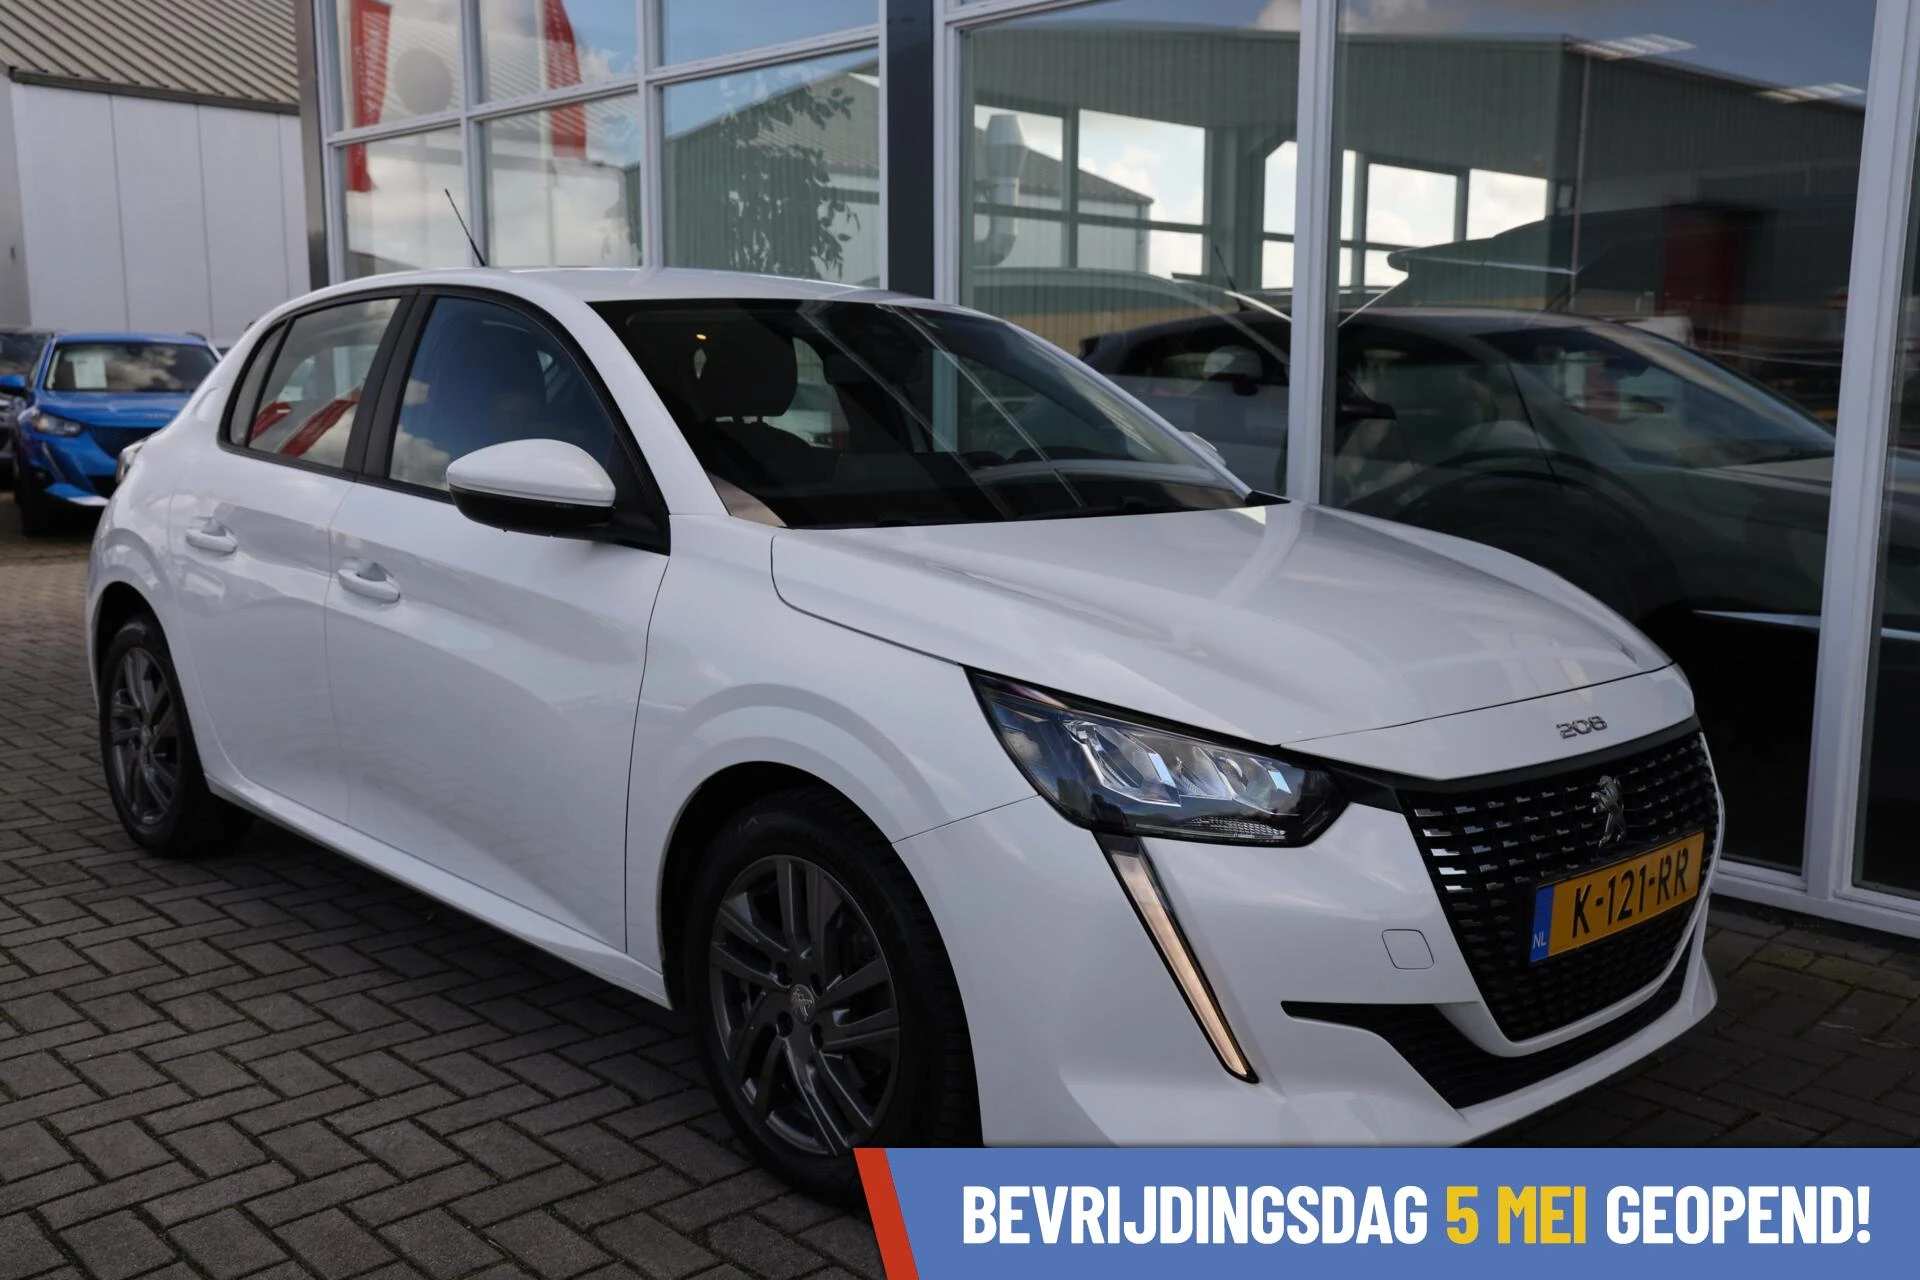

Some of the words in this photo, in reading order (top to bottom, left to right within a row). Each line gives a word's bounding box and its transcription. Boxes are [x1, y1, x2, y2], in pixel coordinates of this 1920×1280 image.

[1556, 716, 1608, 740] 208
[1572, 847, 1689, 938] K-121-RR
[1532, 932, 1548, 948] NL
